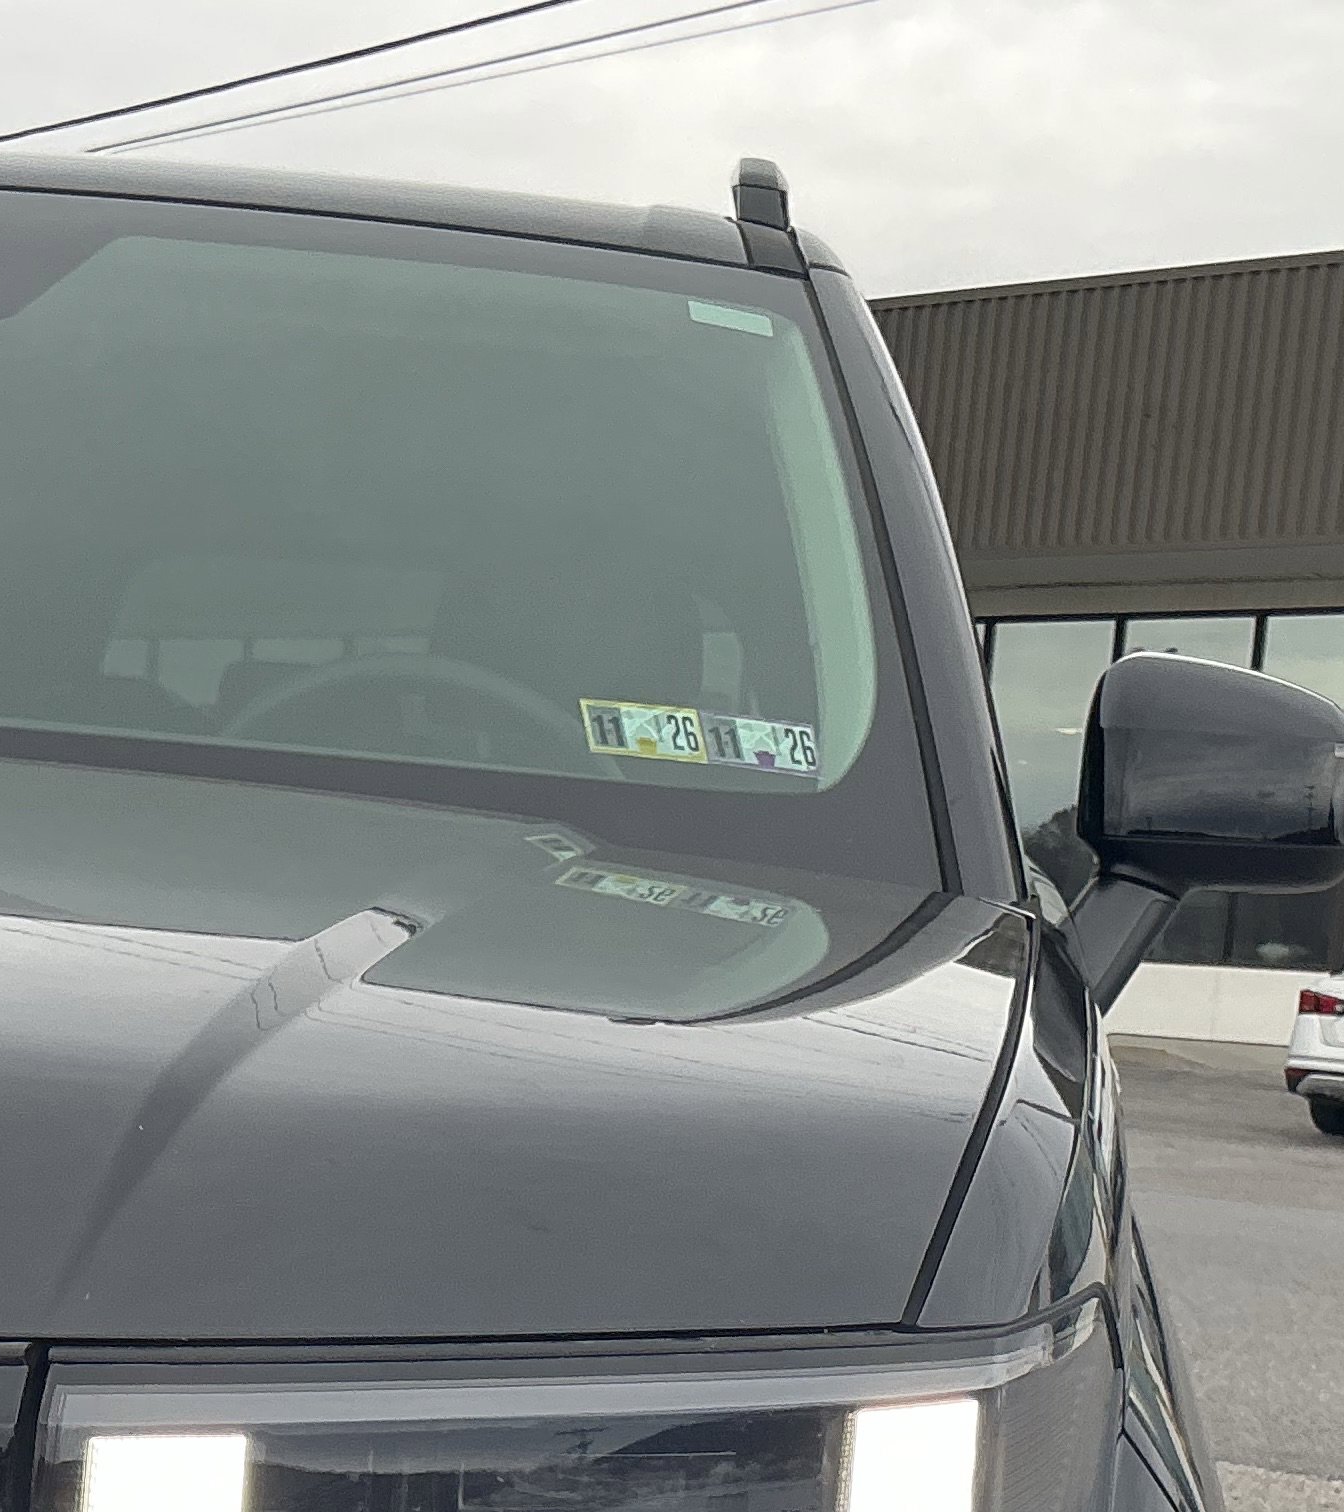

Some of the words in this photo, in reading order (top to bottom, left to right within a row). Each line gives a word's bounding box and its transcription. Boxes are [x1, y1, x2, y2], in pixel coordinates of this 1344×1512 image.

[592, 714, 625, 747] 11
[666, 714, 700, 752] 26
[708, 726, 742, 759] 11
[784, 728, 816, 766] 26
